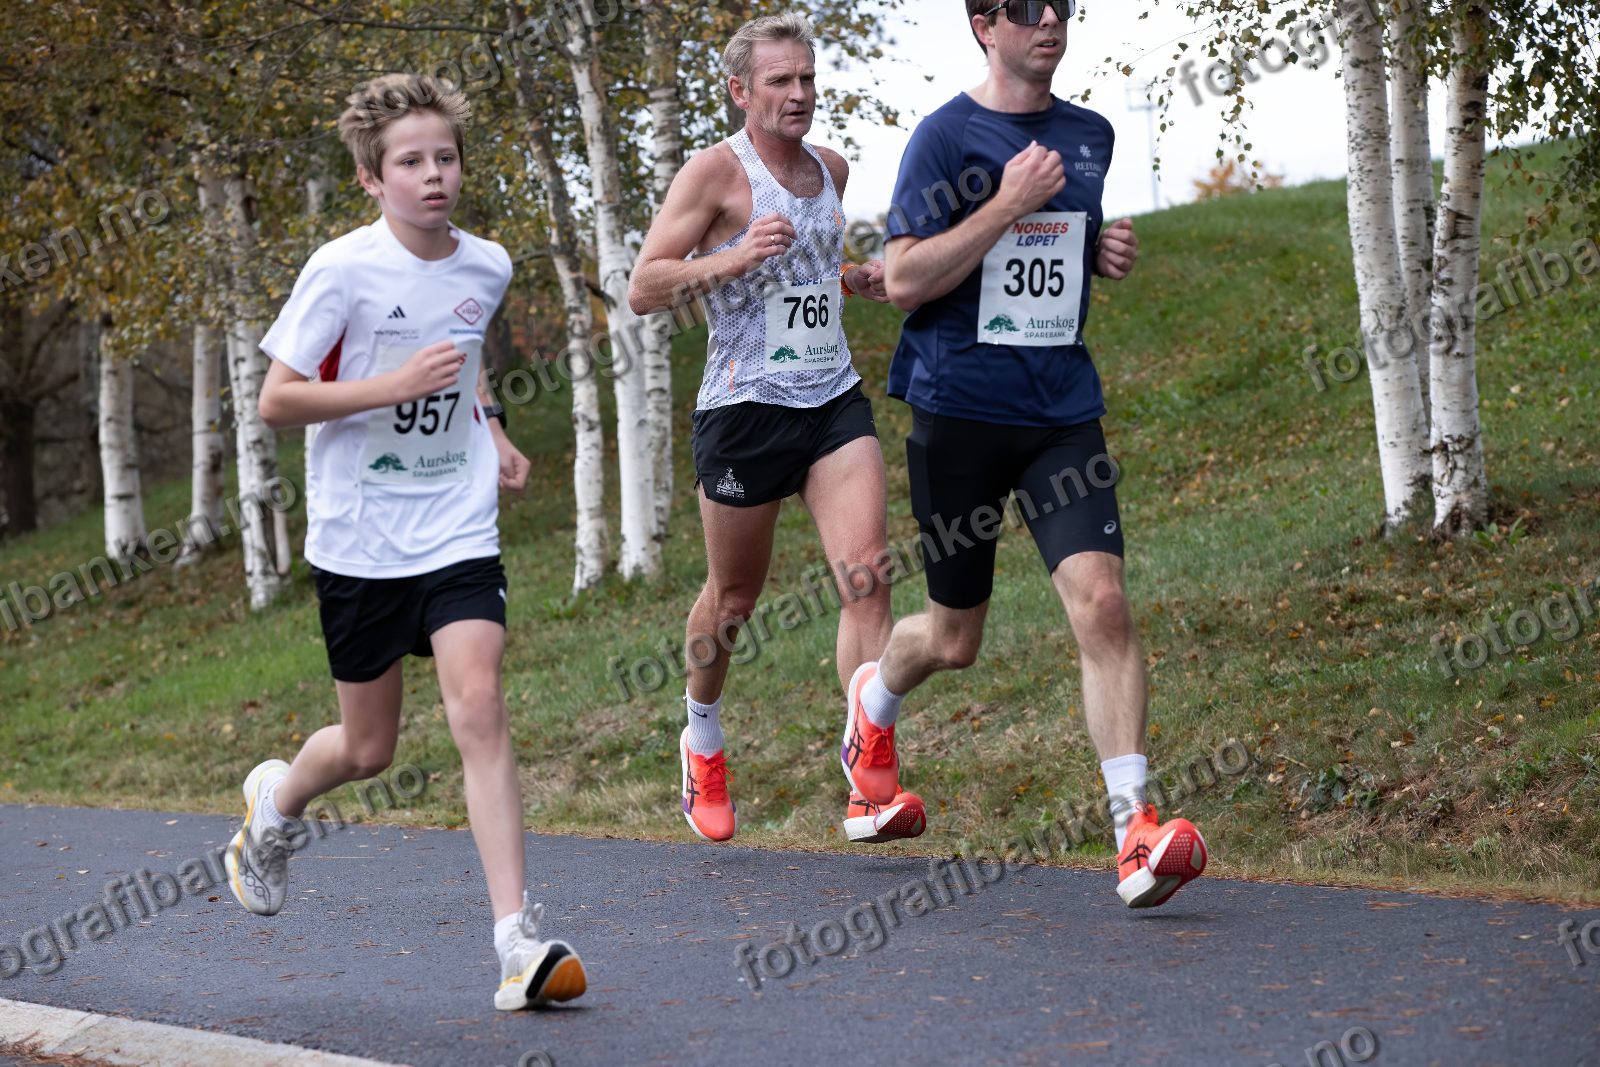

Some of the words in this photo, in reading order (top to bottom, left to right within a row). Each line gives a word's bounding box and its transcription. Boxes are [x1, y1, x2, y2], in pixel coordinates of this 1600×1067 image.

[1011, 222, 1069, 234] NORGES
[1016, 235, 1059, 247] LØPET
[1004, 258, 1064, 297] 305
[783, 294, 829, 329] 766
[1025, 315, 1075, 331] Aurskog
[804, 342, 839, 356] Aurskog
[393, 391, 461, 436] 957
[414, 450, 467, 468] Aurskog
